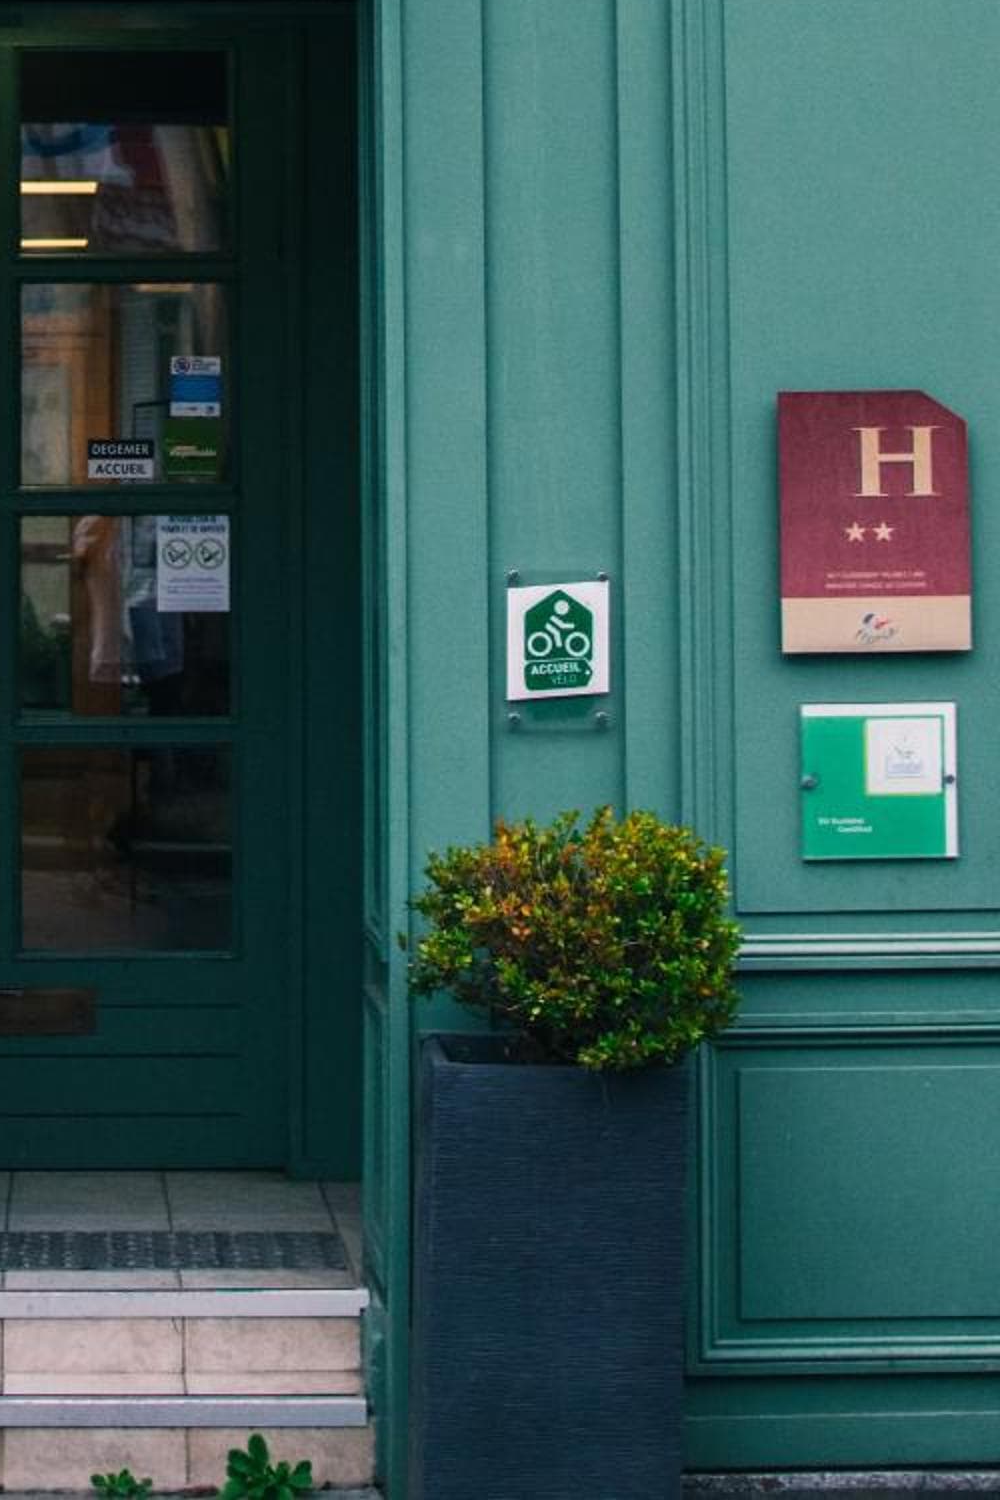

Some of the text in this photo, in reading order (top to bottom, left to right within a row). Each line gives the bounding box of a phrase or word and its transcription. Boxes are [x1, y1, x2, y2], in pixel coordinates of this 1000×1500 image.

[91, 443, 150, 456] DEGEMER
[849, 425, 944, 497] H
[95, 463, 147, 475] ACCUEIL
[531, 662, 581, 675] ACCUEIL
